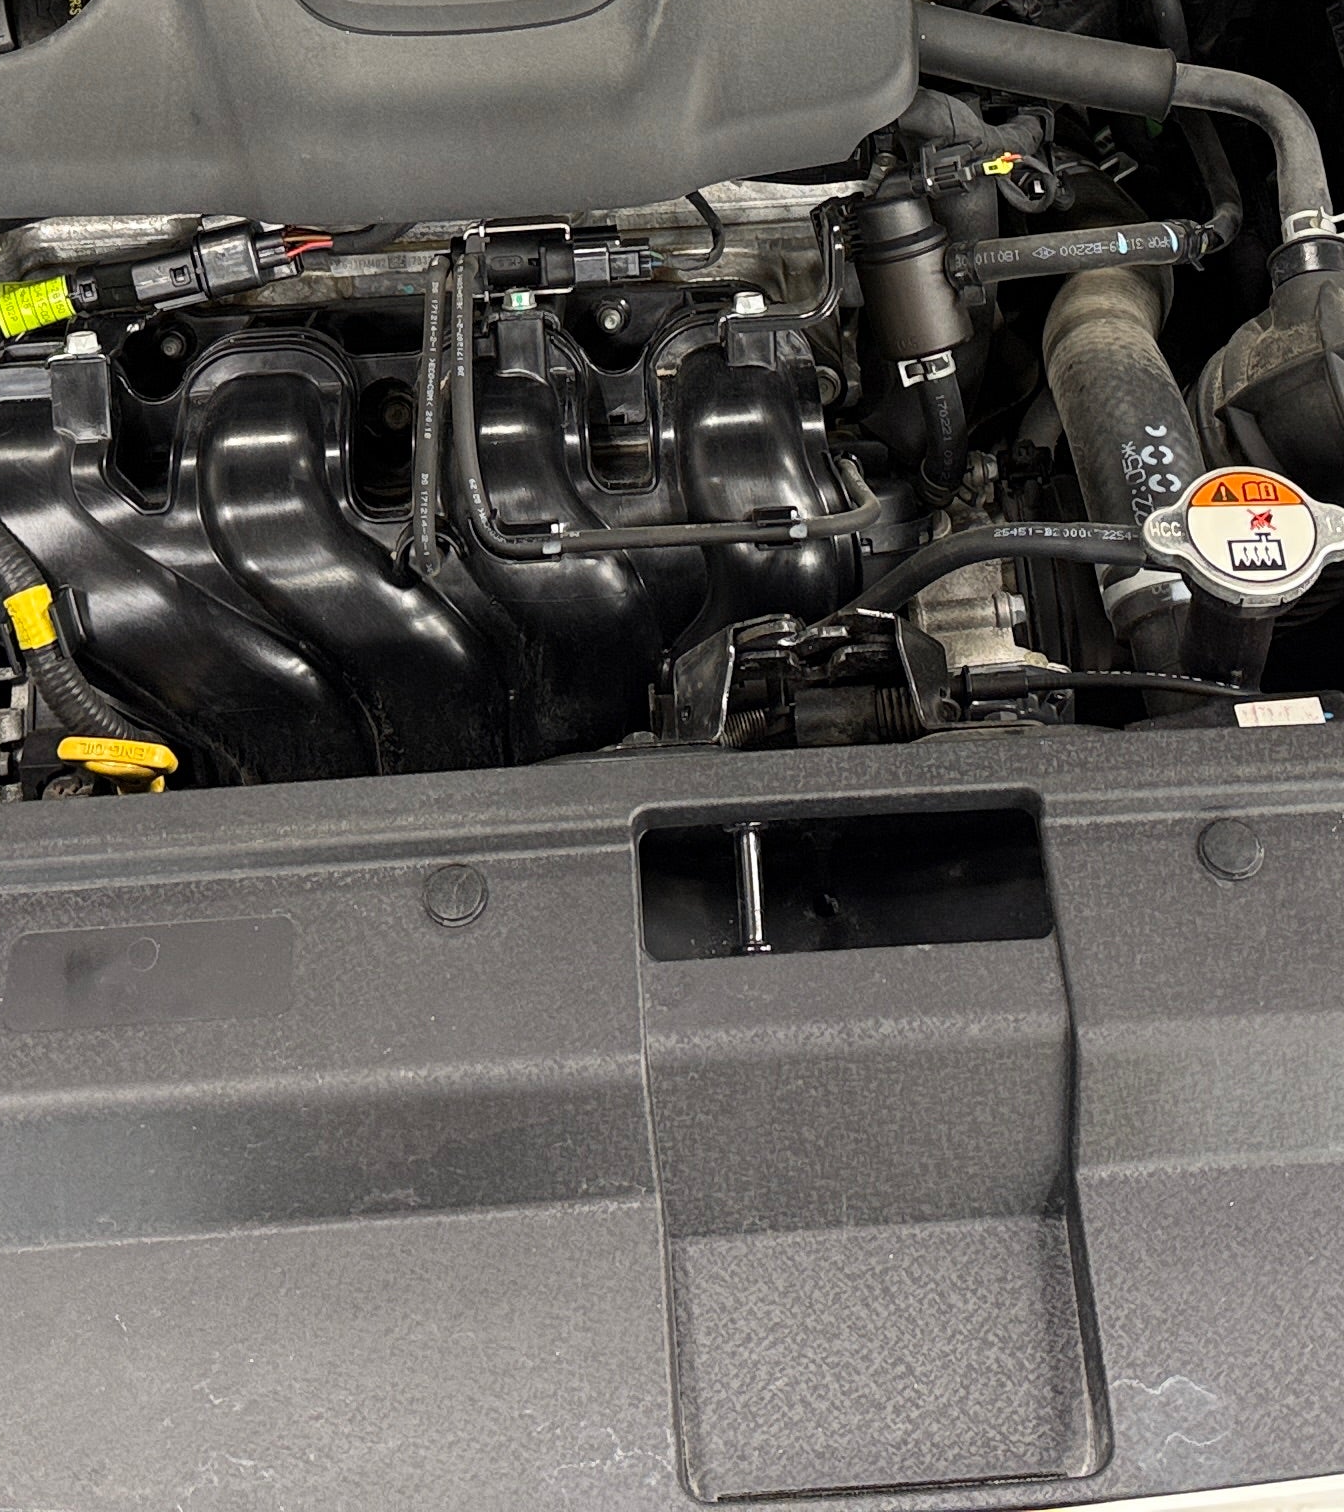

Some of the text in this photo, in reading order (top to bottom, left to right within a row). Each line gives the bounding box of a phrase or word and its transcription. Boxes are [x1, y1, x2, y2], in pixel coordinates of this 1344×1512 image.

[975, 250, 1020, 262] 180110
[1150, 522, 1182, 537] HCC
[80, 742, 146, 760] ENG OIL
